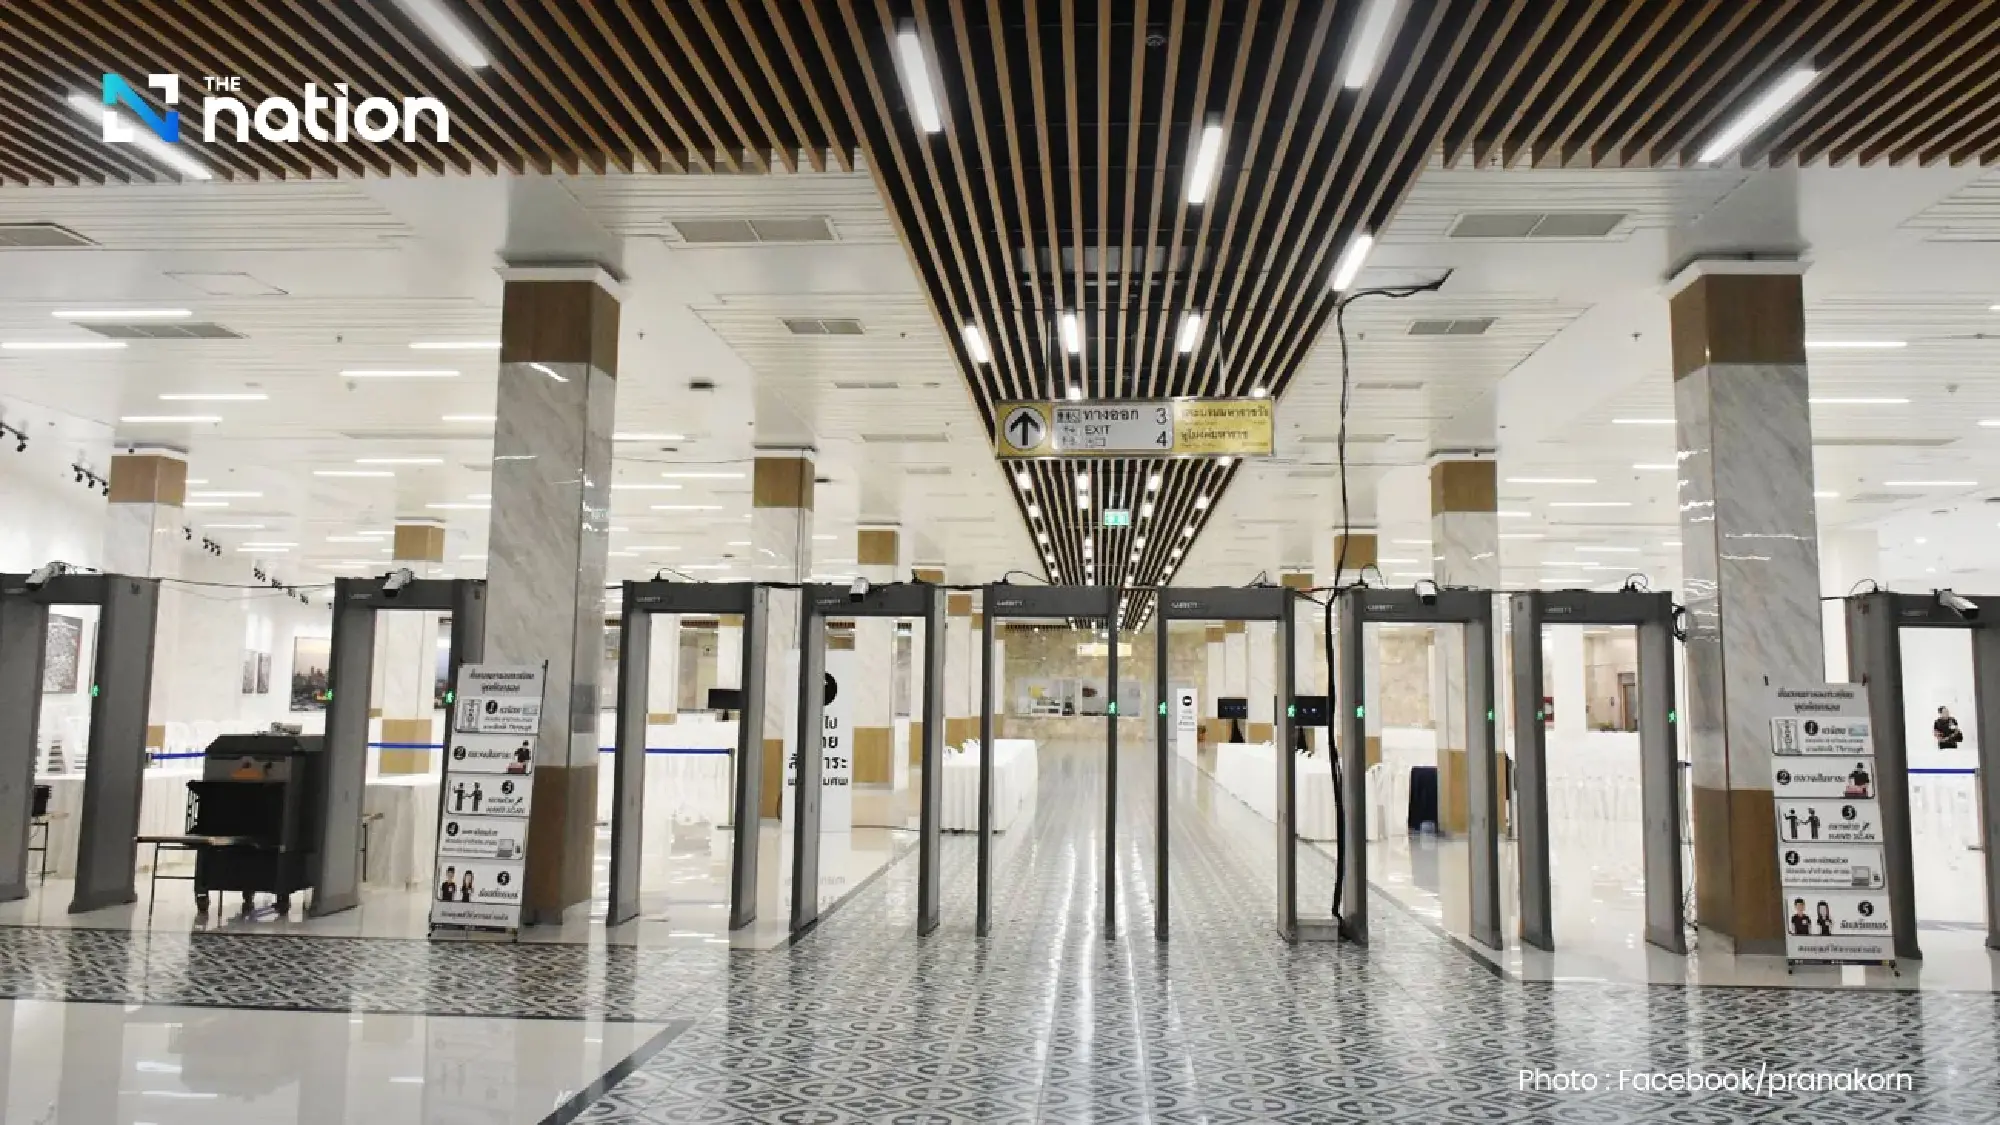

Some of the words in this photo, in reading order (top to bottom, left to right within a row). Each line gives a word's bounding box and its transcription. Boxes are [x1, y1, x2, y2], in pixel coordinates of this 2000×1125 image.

[1083, 409, 1139, 421] ทางออก
[1155, 407, 1168, 425] 3
[1084, 424, 1111, 435] EXIT
[1155, 430, 1168, 447] 4
